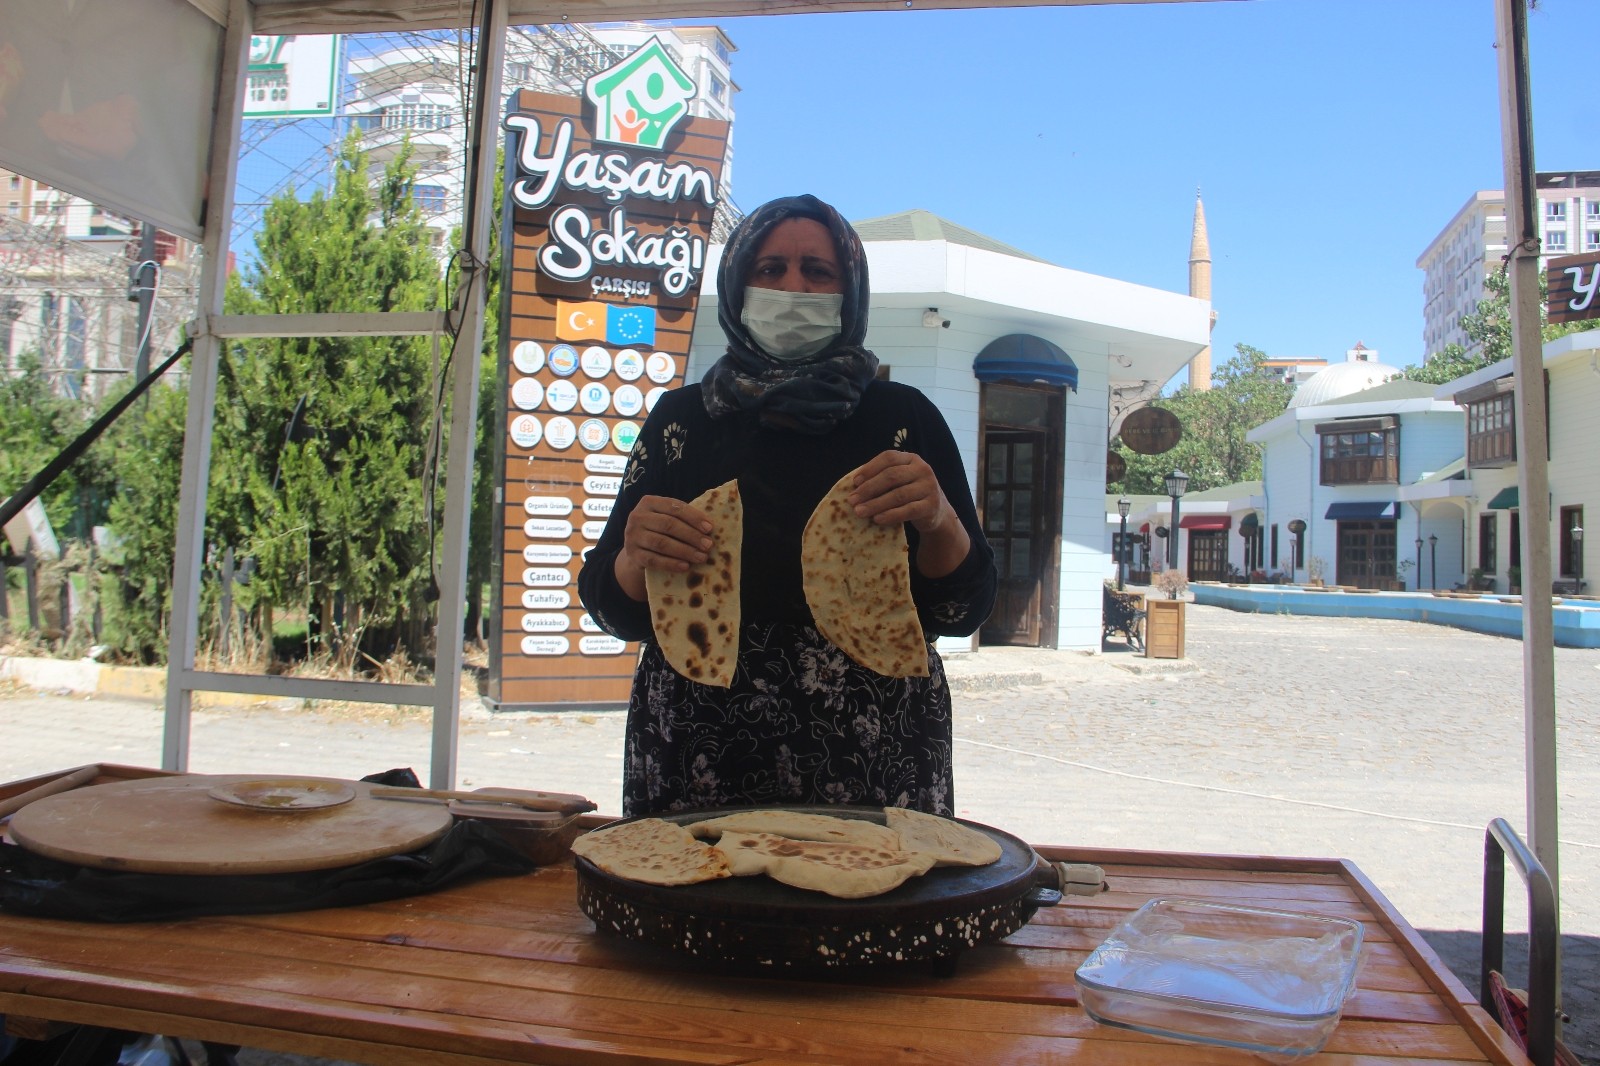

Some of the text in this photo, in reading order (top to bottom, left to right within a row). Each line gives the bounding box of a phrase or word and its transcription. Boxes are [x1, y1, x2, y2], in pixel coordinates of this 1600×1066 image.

[504, 114, 717, 207] Yaşam
[540, 206, 703, 296] Sokağı
[591, 276, 650, 298] ÇARŞISI
[590, 481, 622, 490] Çeyiz Ev
[528, 502, 548, 510] Organik
[588, 503, 612, 511] Kafete
[530, 572, 564, 583] Çantacı
[529, 595, 564, 604] Tuhafiye
[526, 619, 565, 629] Ayakkabıcı
